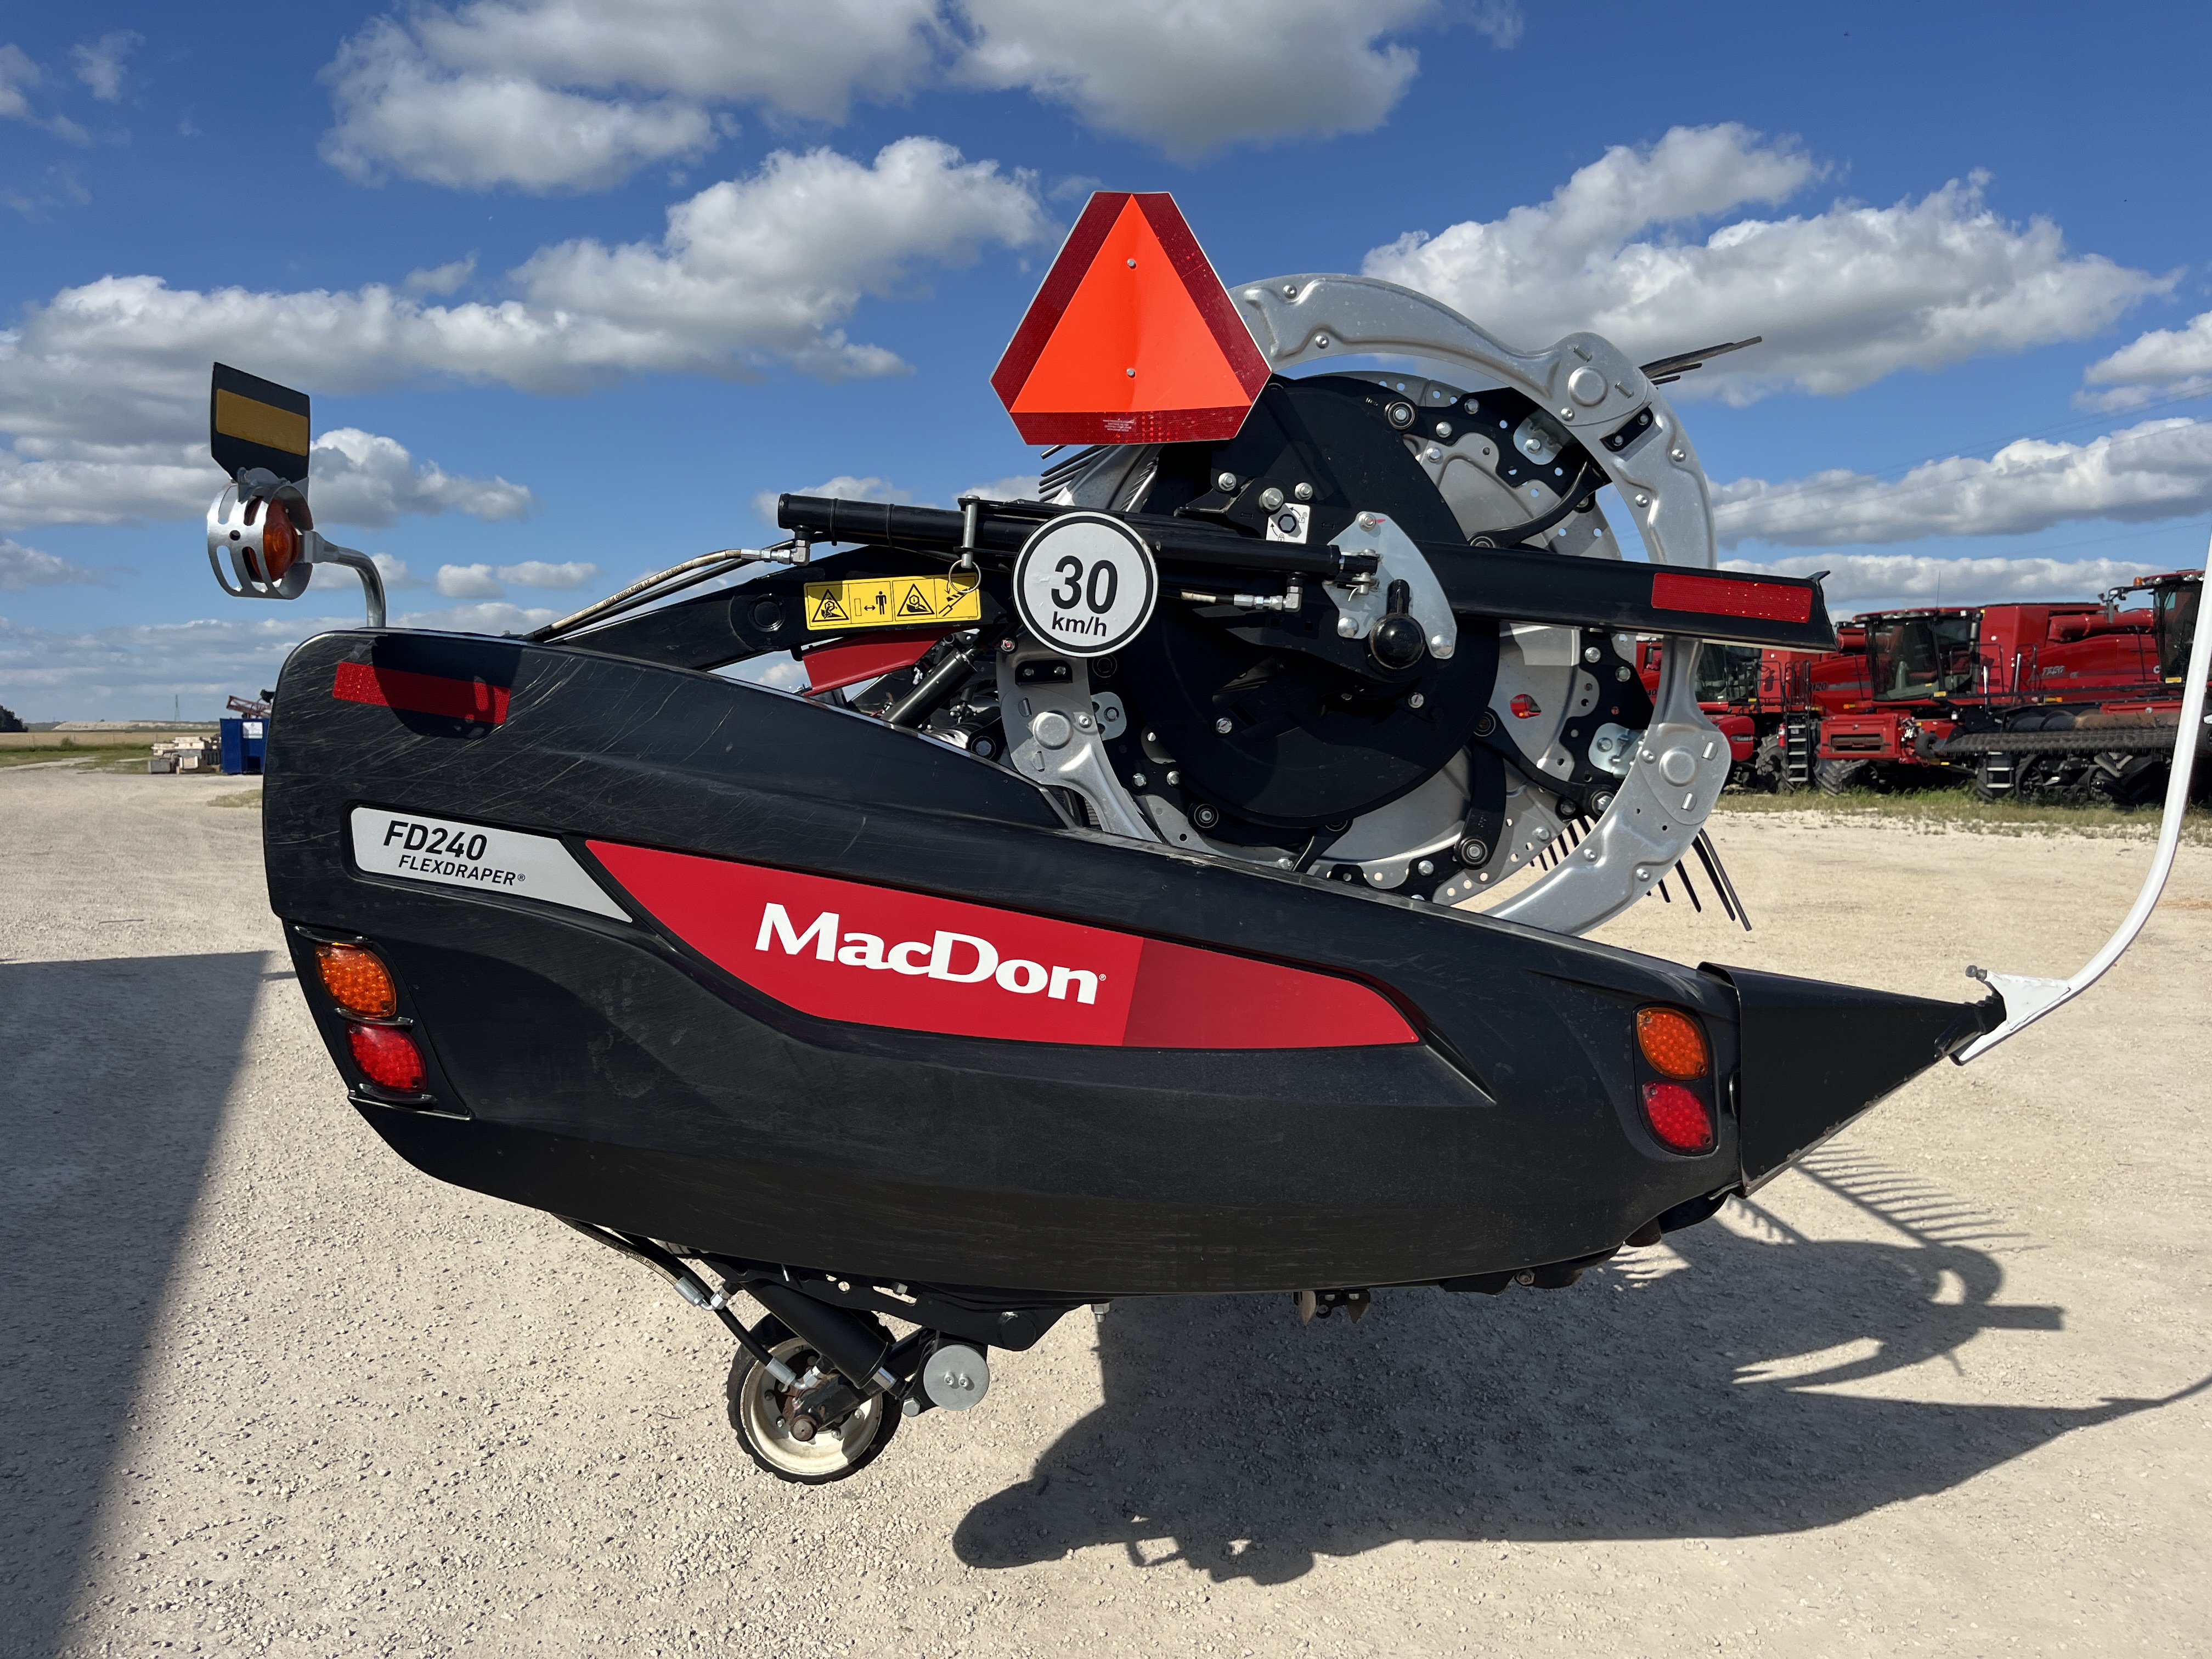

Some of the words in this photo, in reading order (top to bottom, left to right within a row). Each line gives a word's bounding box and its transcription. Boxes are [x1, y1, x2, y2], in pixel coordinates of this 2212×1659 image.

[631, 583, 644, 591] MPa
[1051, 555, 1118, 614] 30
[603, 596, 616, 606] PSI)
[616, 589, 631, 600] (3000
[1052, 611, 1107, 636] km/h
[383, 820, 488, 861] FD240
[398, 855, 526, 885] FLEXDRAPER®
[645, 1259, 657, 1269] PSI)
